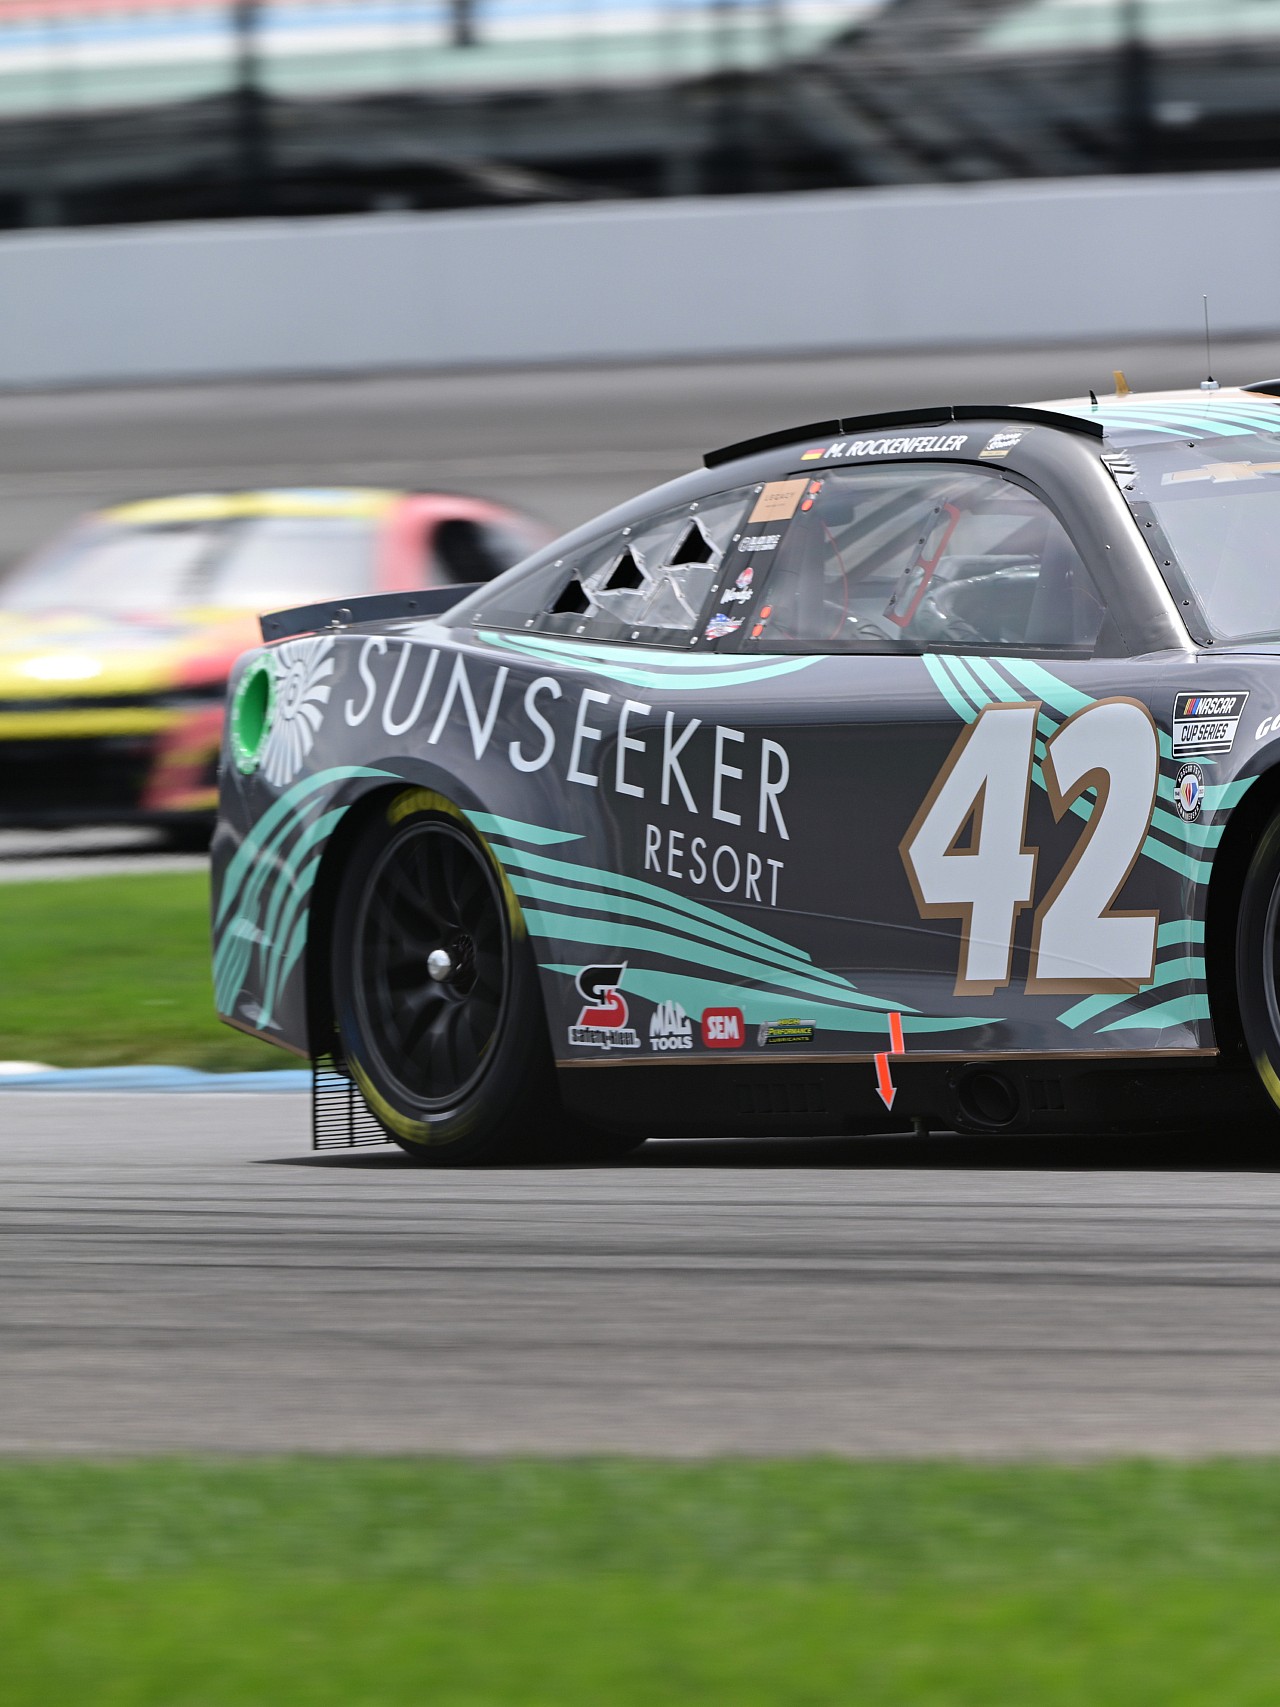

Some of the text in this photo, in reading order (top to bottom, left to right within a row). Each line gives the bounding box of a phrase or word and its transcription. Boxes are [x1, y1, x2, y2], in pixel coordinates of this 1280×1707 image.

[824, 443, 842, 458] M.
[845, 435, 968, 457] ROCKENFELLER
[1197, 697, 1237, 715] NASCAR
[345, 635, 790, 840] SUNSEEKER
[1181, 722, 1229, 742] CUP SERIES
[898, 696, 1160, 996] 42
[645, 824, 785, 907] RESORT
[649, 1000, 692, 1037] MAC
[707, 1016, 740, 1039] SEM
[650, 1037, 693, 1050] TOOLS
